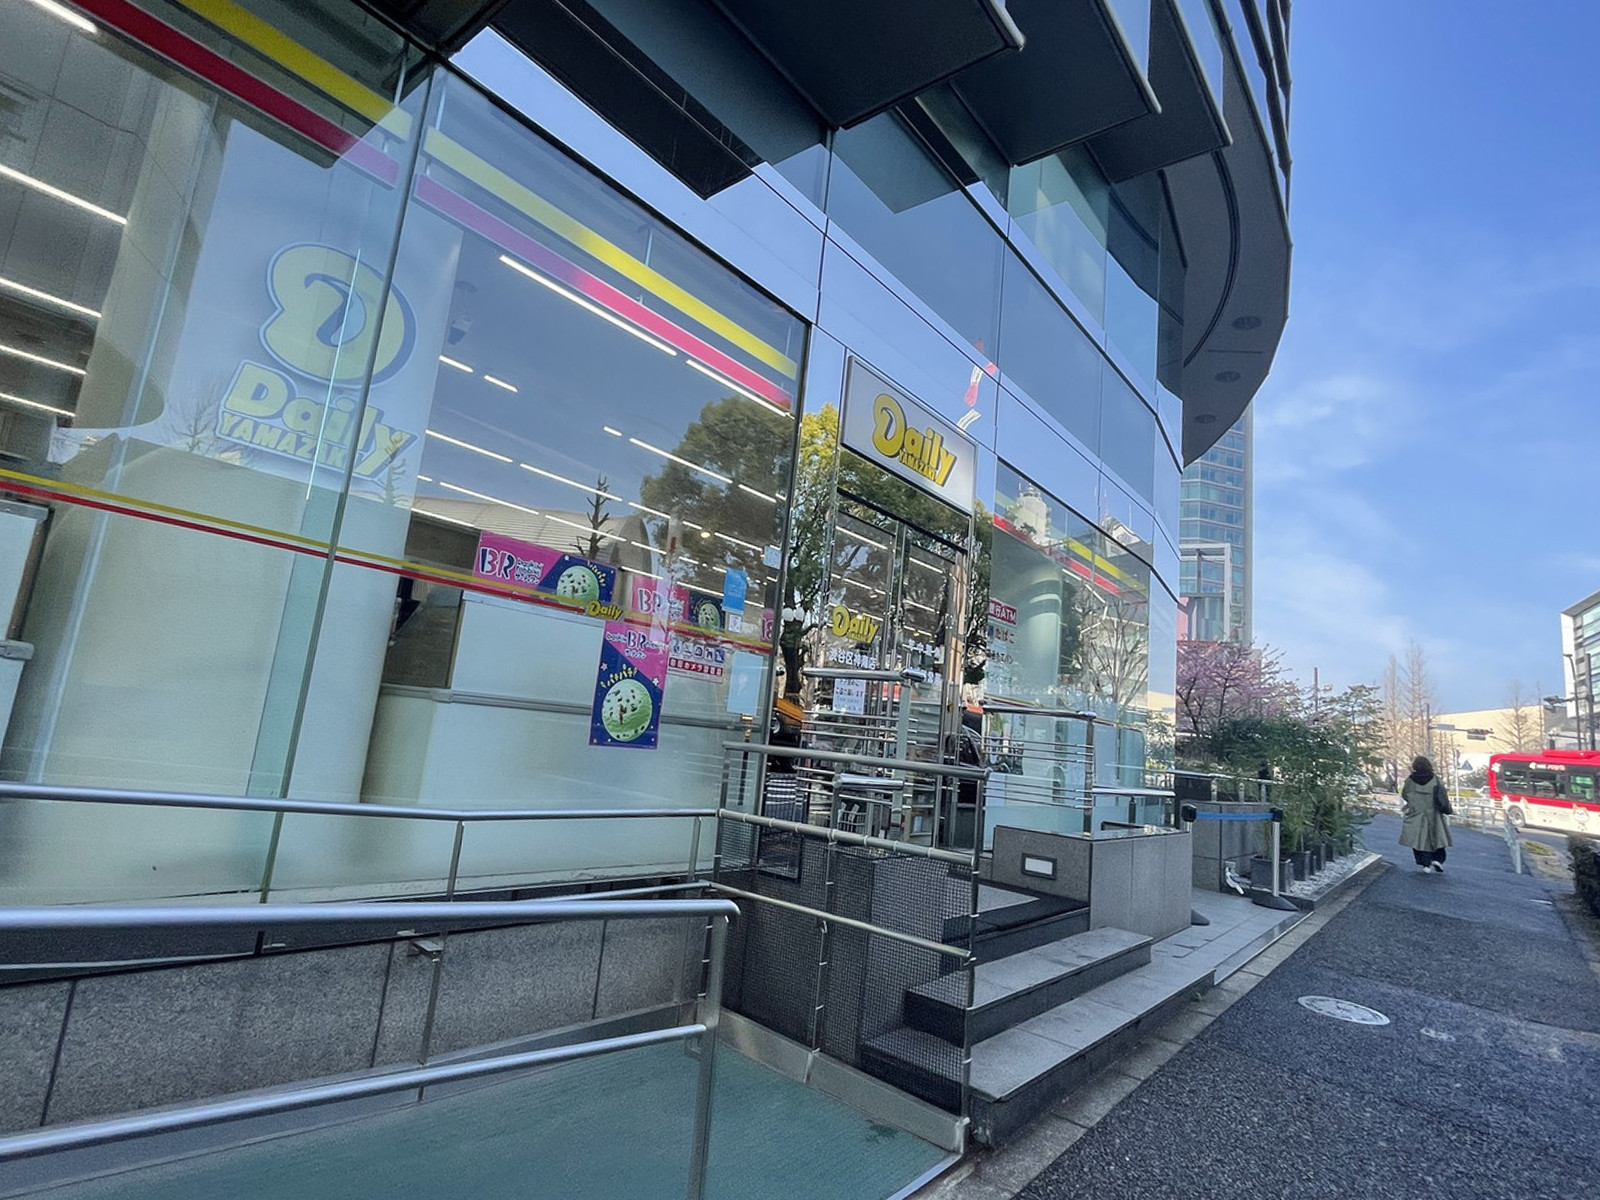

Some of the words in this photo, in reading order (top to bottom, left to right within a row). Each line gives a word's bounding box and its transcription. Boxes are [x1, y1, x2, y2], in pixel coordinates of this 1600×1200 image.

[221, 361, 415, 477] Daily
[218, 411, 350, 468] YAMAZAK
[872, 393, 957, 487] Daily
[479, 546, 516, 580] BR
[588, 600, 623, 621] Daily
[832, 604, 880, 643] Daily
[627, 630, 647, 650] BR
